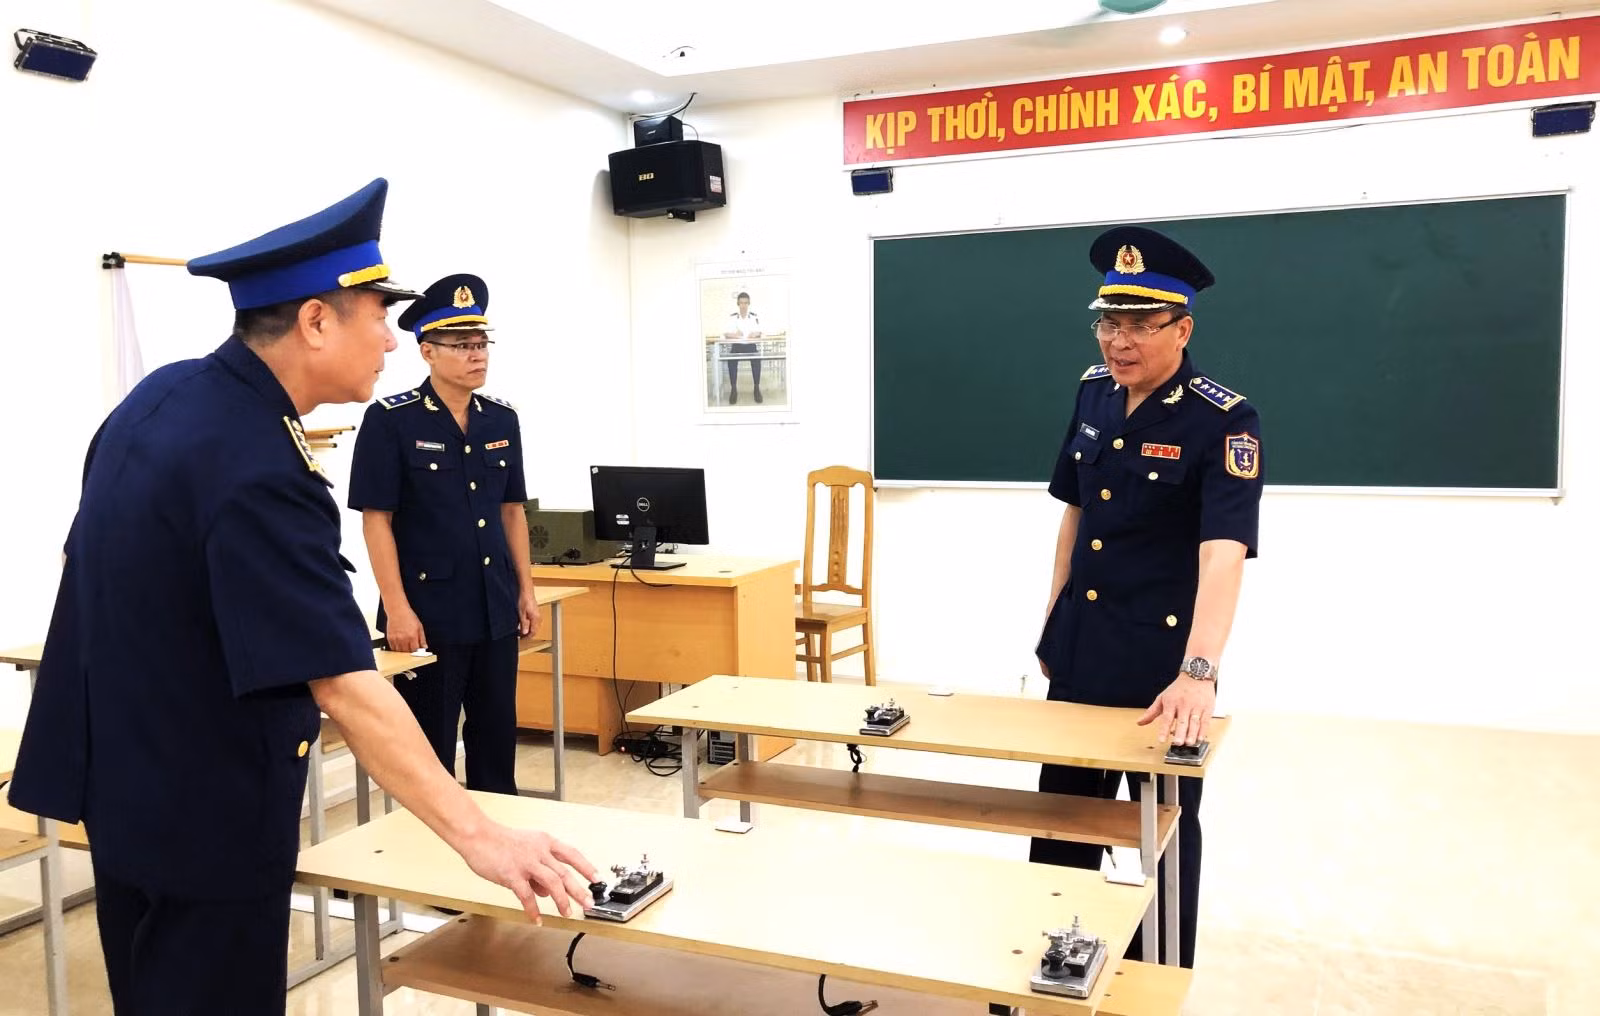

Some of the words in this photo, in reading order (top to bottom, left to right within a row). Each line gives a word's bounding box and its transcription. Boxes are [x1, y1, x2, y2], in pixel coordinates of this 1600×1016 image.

[865, 111, 917, 154] KỊP
[927, 91, 1006, 143] THỜI,
[1013, 85, 1119, 135] CHÍNH
[1132, 73, 1218, 122] XÁC,
[1232, 63, 1275, 114] BÍ
[1283, 55, 1375, 112] MẬT,
[1388, 51, 1448, 98] AN
[1462, 32, 1580, 90] TOÀN
